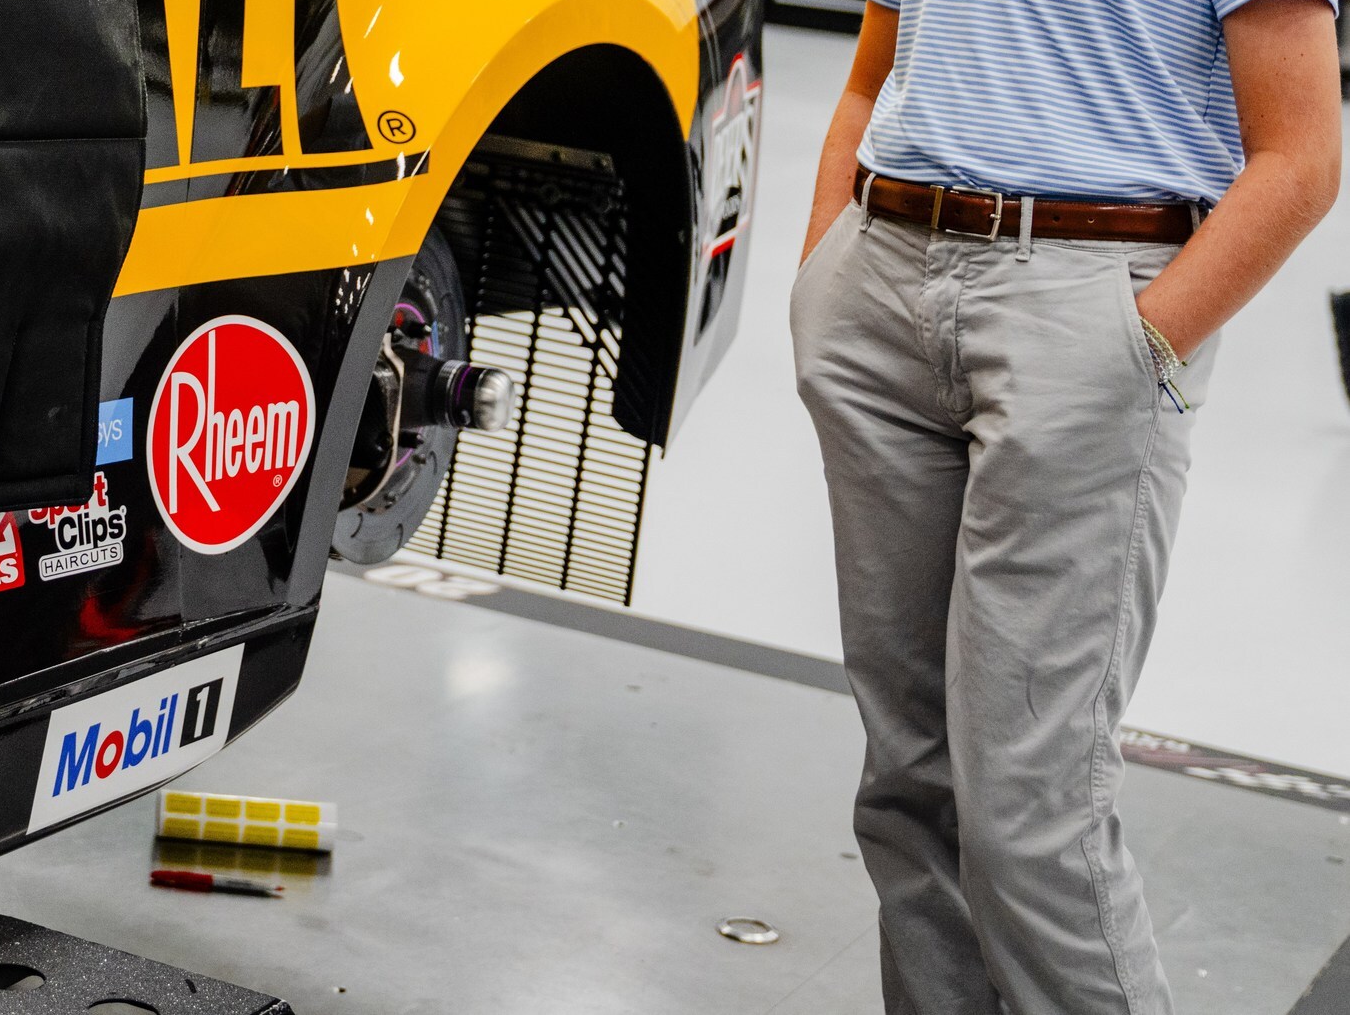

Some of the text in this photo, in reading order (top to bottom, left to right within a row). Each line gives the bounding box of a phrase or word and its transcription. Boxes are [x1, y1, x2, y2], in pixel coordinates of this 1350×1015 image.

[168, 329, 300, 515] Rheem
[44, 546, 119, 576] HAIRCUTS
[57, 513, 124, 551] Clips
[51, 692, 179, 798] Mobil
